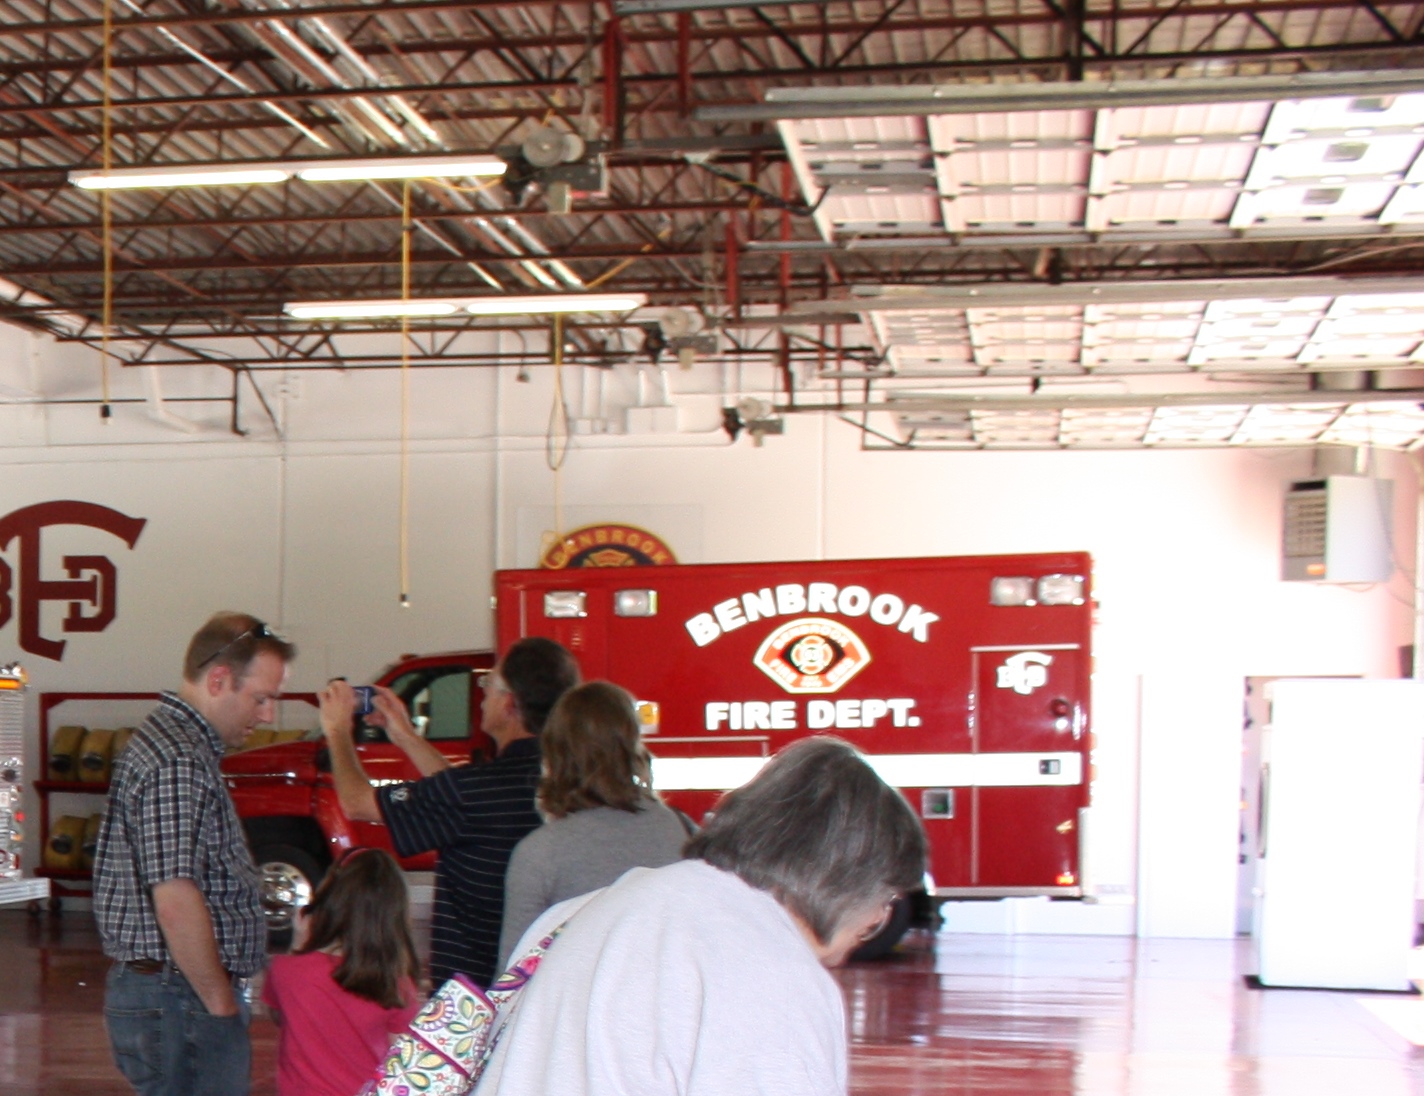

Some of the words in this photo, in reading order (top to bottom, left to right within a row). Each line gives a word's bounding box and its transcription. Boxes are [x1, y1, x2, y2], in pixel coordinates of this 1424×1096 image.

[684, 582, 940, 647] BENBROOK
[705, 700, 798, 731] FIRE
[806, 698, 921, 729] DEPT.
